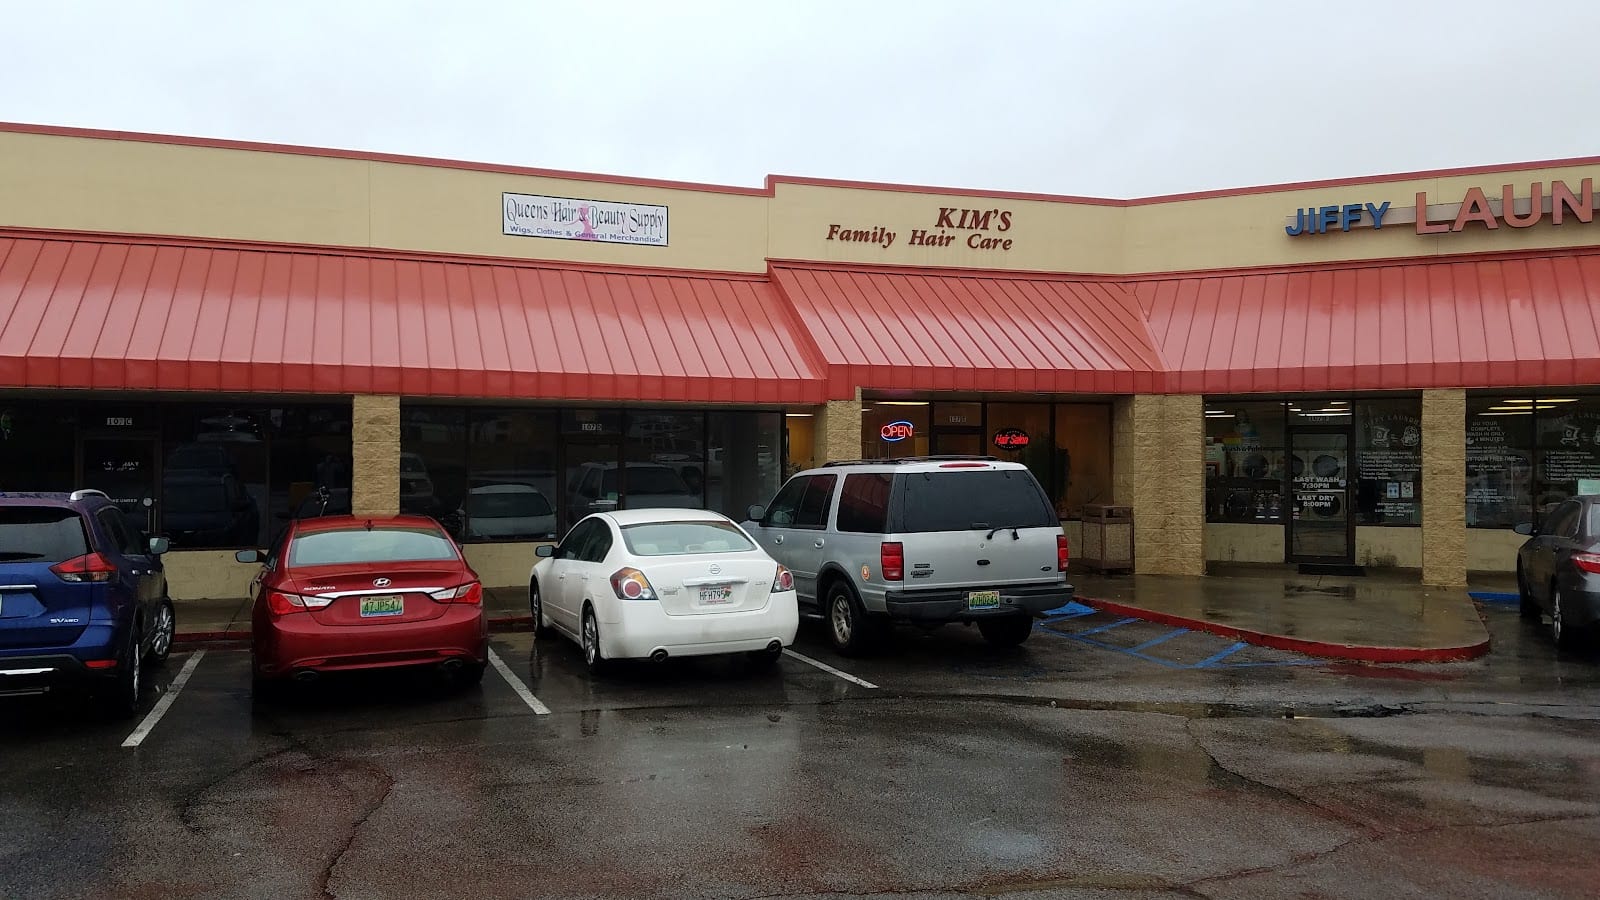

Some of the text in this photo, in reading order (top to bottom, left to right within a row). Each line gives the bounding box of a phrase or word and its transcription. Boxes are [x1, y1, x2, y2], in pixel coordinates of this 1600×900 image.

[506, 199, 664, 239] Queens Hair & Beauty Supply
[935, 207, 1012, 232] KIM'S
[1285, 201, 1391, 236] JIFFY
[510, 226, 534, 234] Wigs,
[537, 228, 562, 236] Clothes
[575, 231, 607, 239] General
[610, 234, 662, 243] Merchandise
[826, 224, 1013, 250] Family Hair Care
[881, 424, 914, 437] OPEN
[995, 434, 1010, 445] Hair
